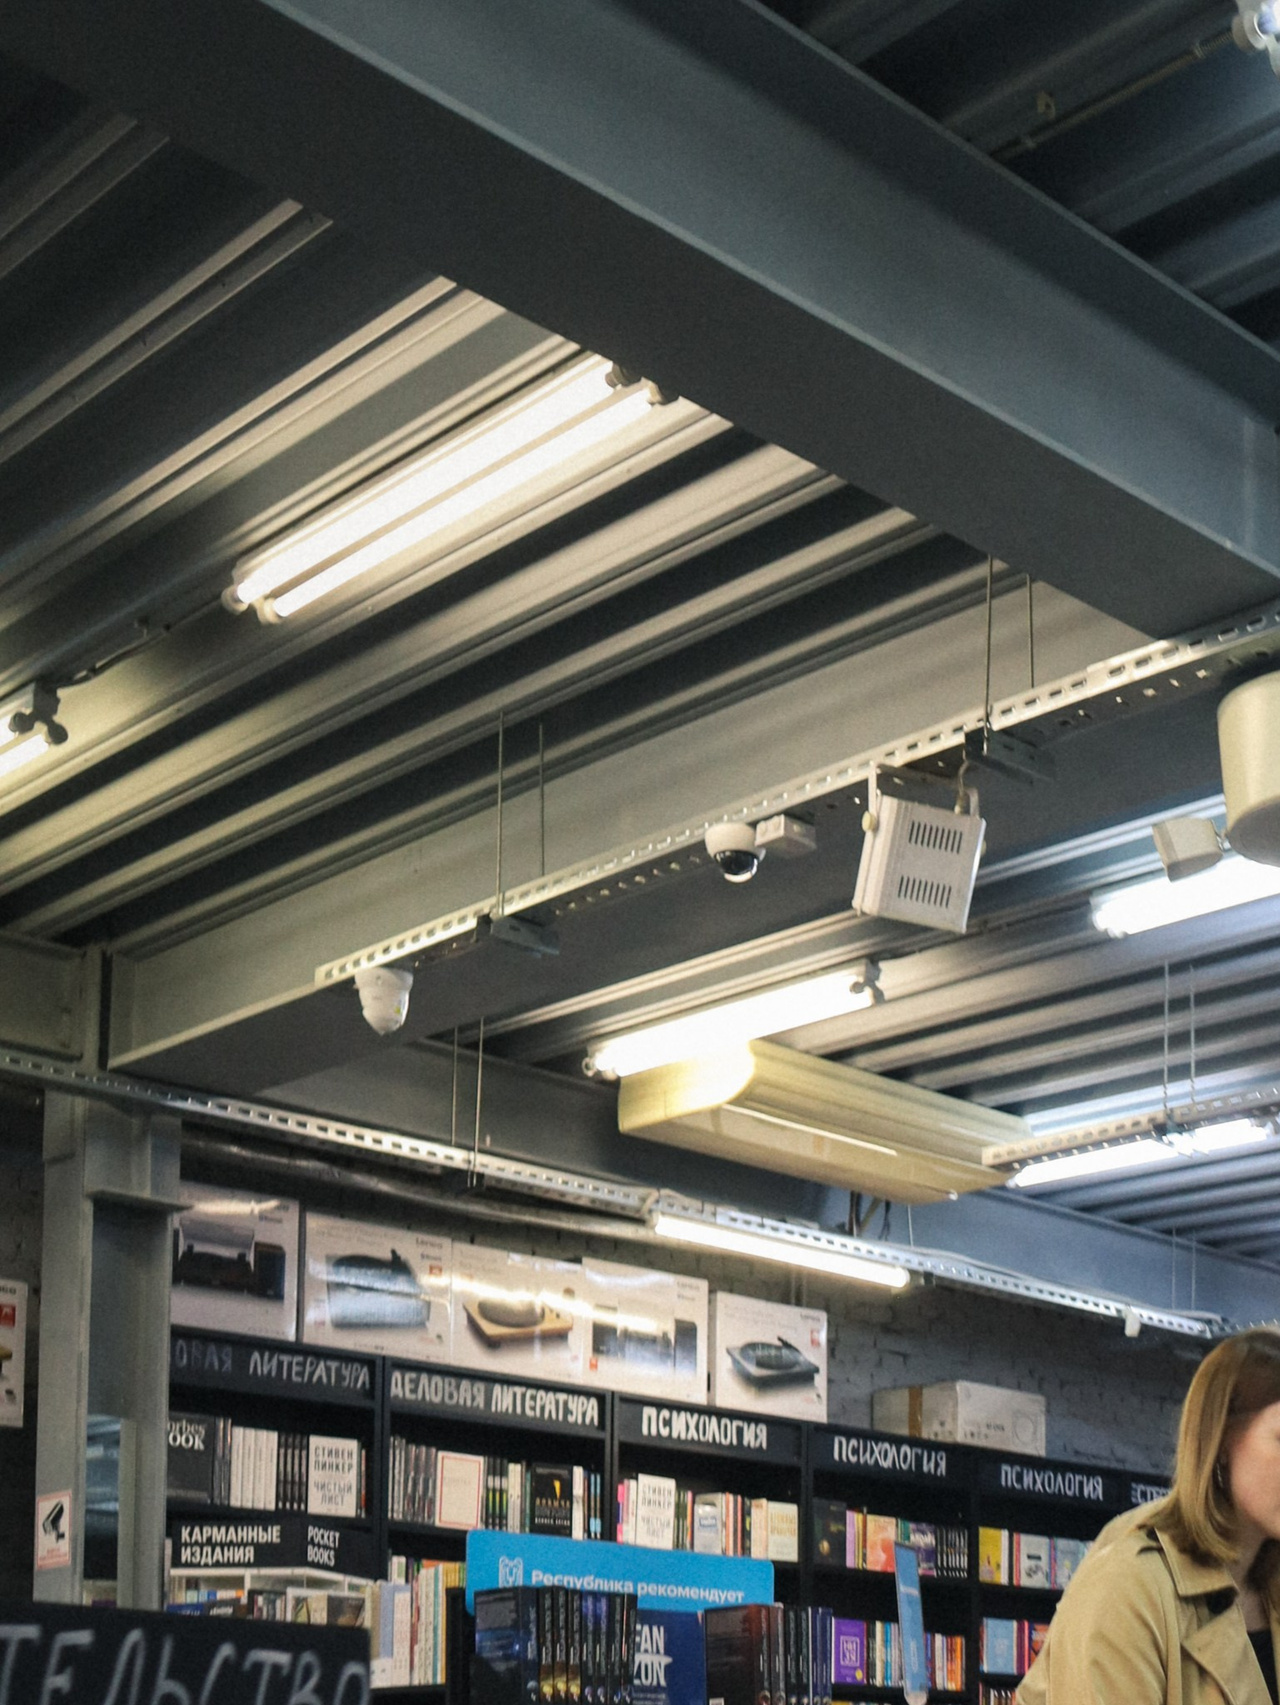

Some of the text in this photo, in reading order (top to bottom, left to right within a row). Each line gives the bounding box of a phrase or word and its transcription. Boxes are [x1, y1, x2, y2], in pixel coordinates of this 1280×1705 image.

[249, 1350, 371, 1390] ЛИТЕРАТУРА
[390, 1370, 599, 1427] ДЕЛОВАЯ ЛИТЕРАТУРА
[642, 1407, 768, 1450] ПСИХОЛОГИЯ
[314, 1445, 354, 1461] СТИВЕН
[314, 1460, 354, 1473] ПИНКЕР
[833, 1435, 947, 1477] ПСИХОЛОГИЯ
[1000, 1463, 1104, 1502] ПСИХОЛОГИЯ
[181, 1525, 281, 1544] КАРМАННЫЕ
[307, 1525, 340, 1549] POCKET
[181, 1545, 255, 1566] ИЗДАНИЯ
[307, 1544, 336, 1567] BOOKS
[531, 1570, 745, 1605] Республика рекомендует
